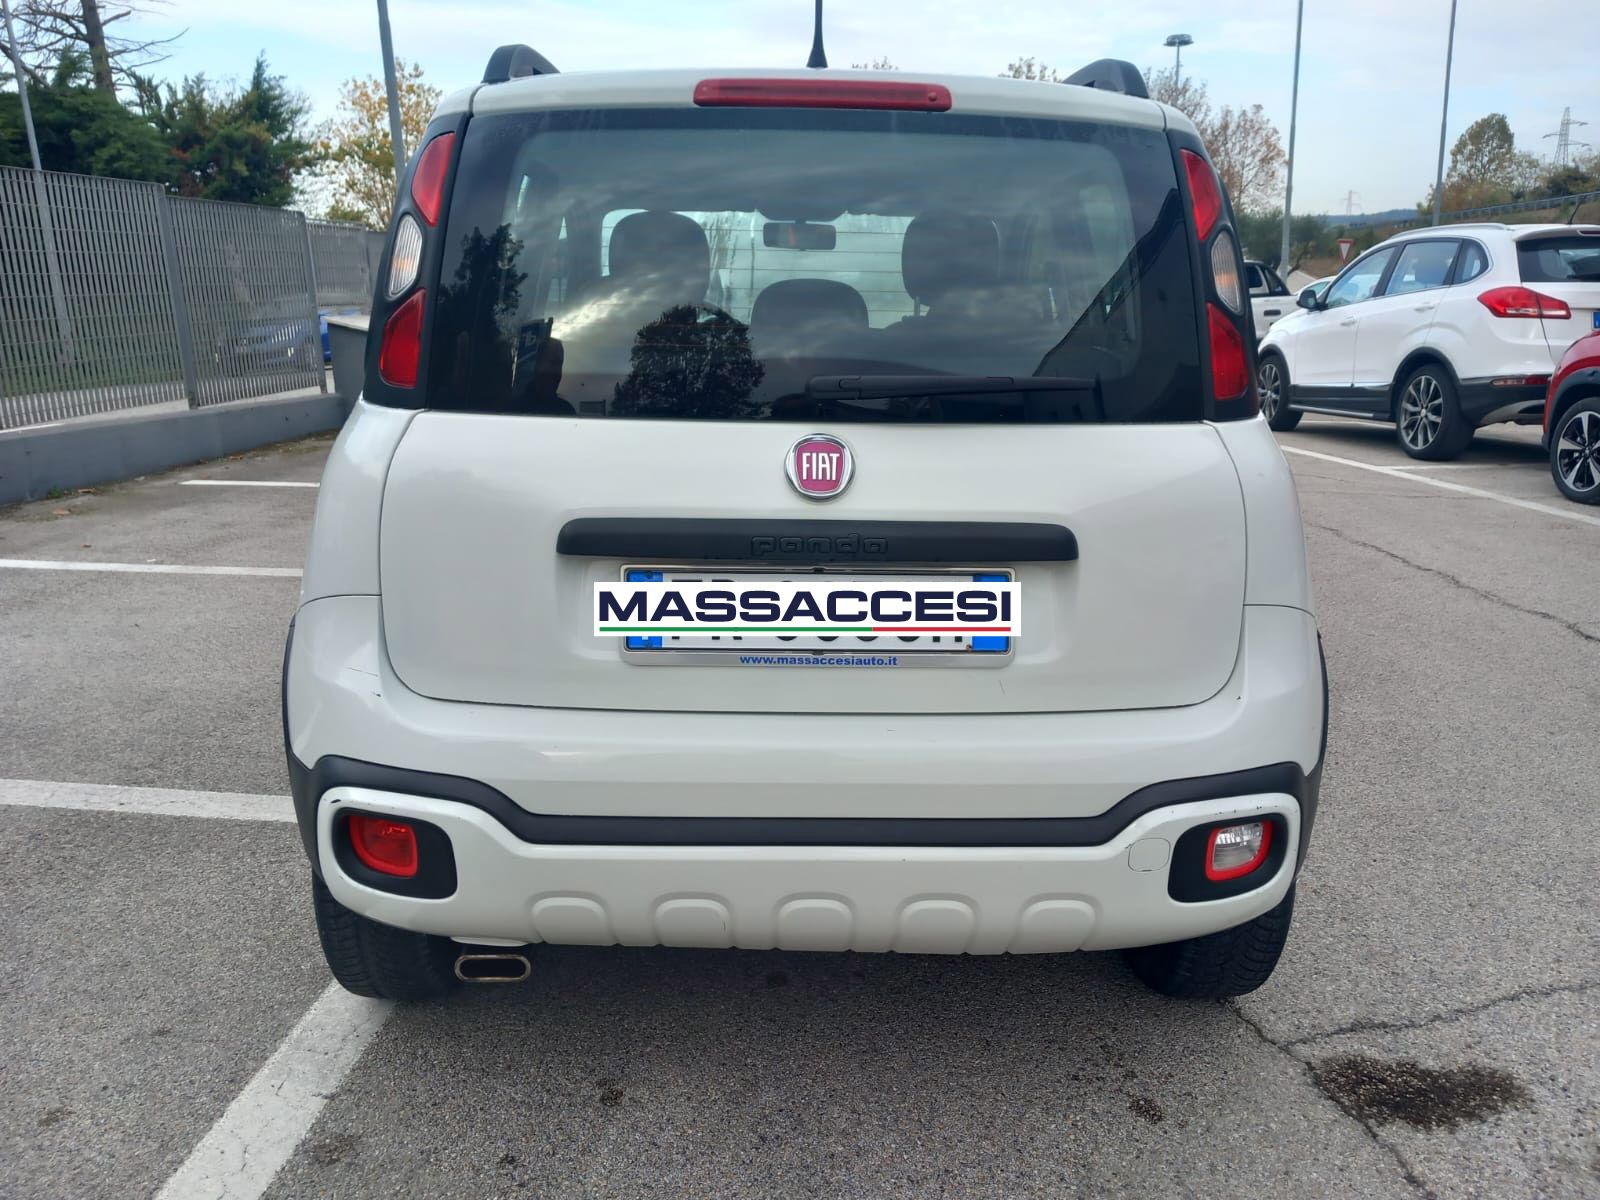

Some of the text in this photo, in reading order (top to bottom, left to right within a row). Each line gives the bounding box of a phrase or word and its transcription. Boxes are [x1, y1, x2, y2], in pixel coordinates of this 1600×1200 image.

[802, 452, 840, 481] FIAT
[751, 532, 888, 556] panda
[740, 655, 898, 666] www.massaccesiauto.it
